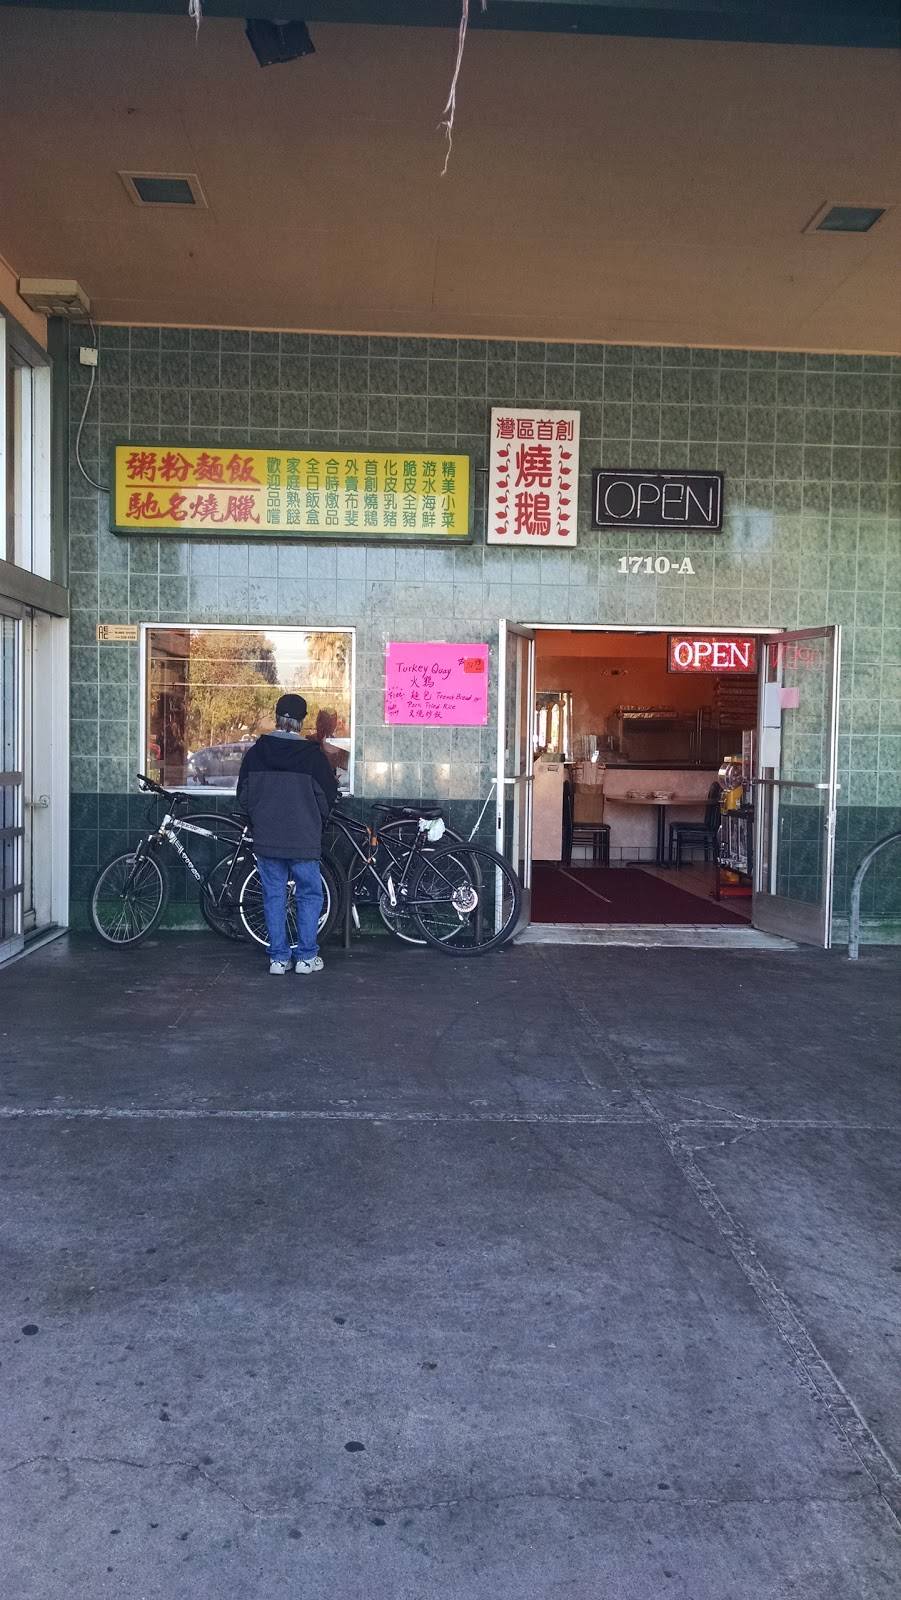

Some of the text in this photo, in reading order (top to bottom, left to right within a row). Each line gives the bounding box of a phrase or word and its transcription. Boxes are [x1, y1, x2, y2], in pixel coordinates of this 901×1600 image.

[496, 417, 574, 441] 灣區首創
[305, 457, 320, 525] 全日飯盒
[363, 459, 378, 527] 首創燒鵝
[421, 460, 436, 529] 游水海鮮
[441, 460, 456, 529] 精美小菜
[514, 443, 552, 536] 燒鵝
[604, 481, 713, 521] OPEN
[617, 556, 696, 575] 1710-A
[395, 662, 429, 679] Turkey
[673, 641, 751, 667] OPEN
